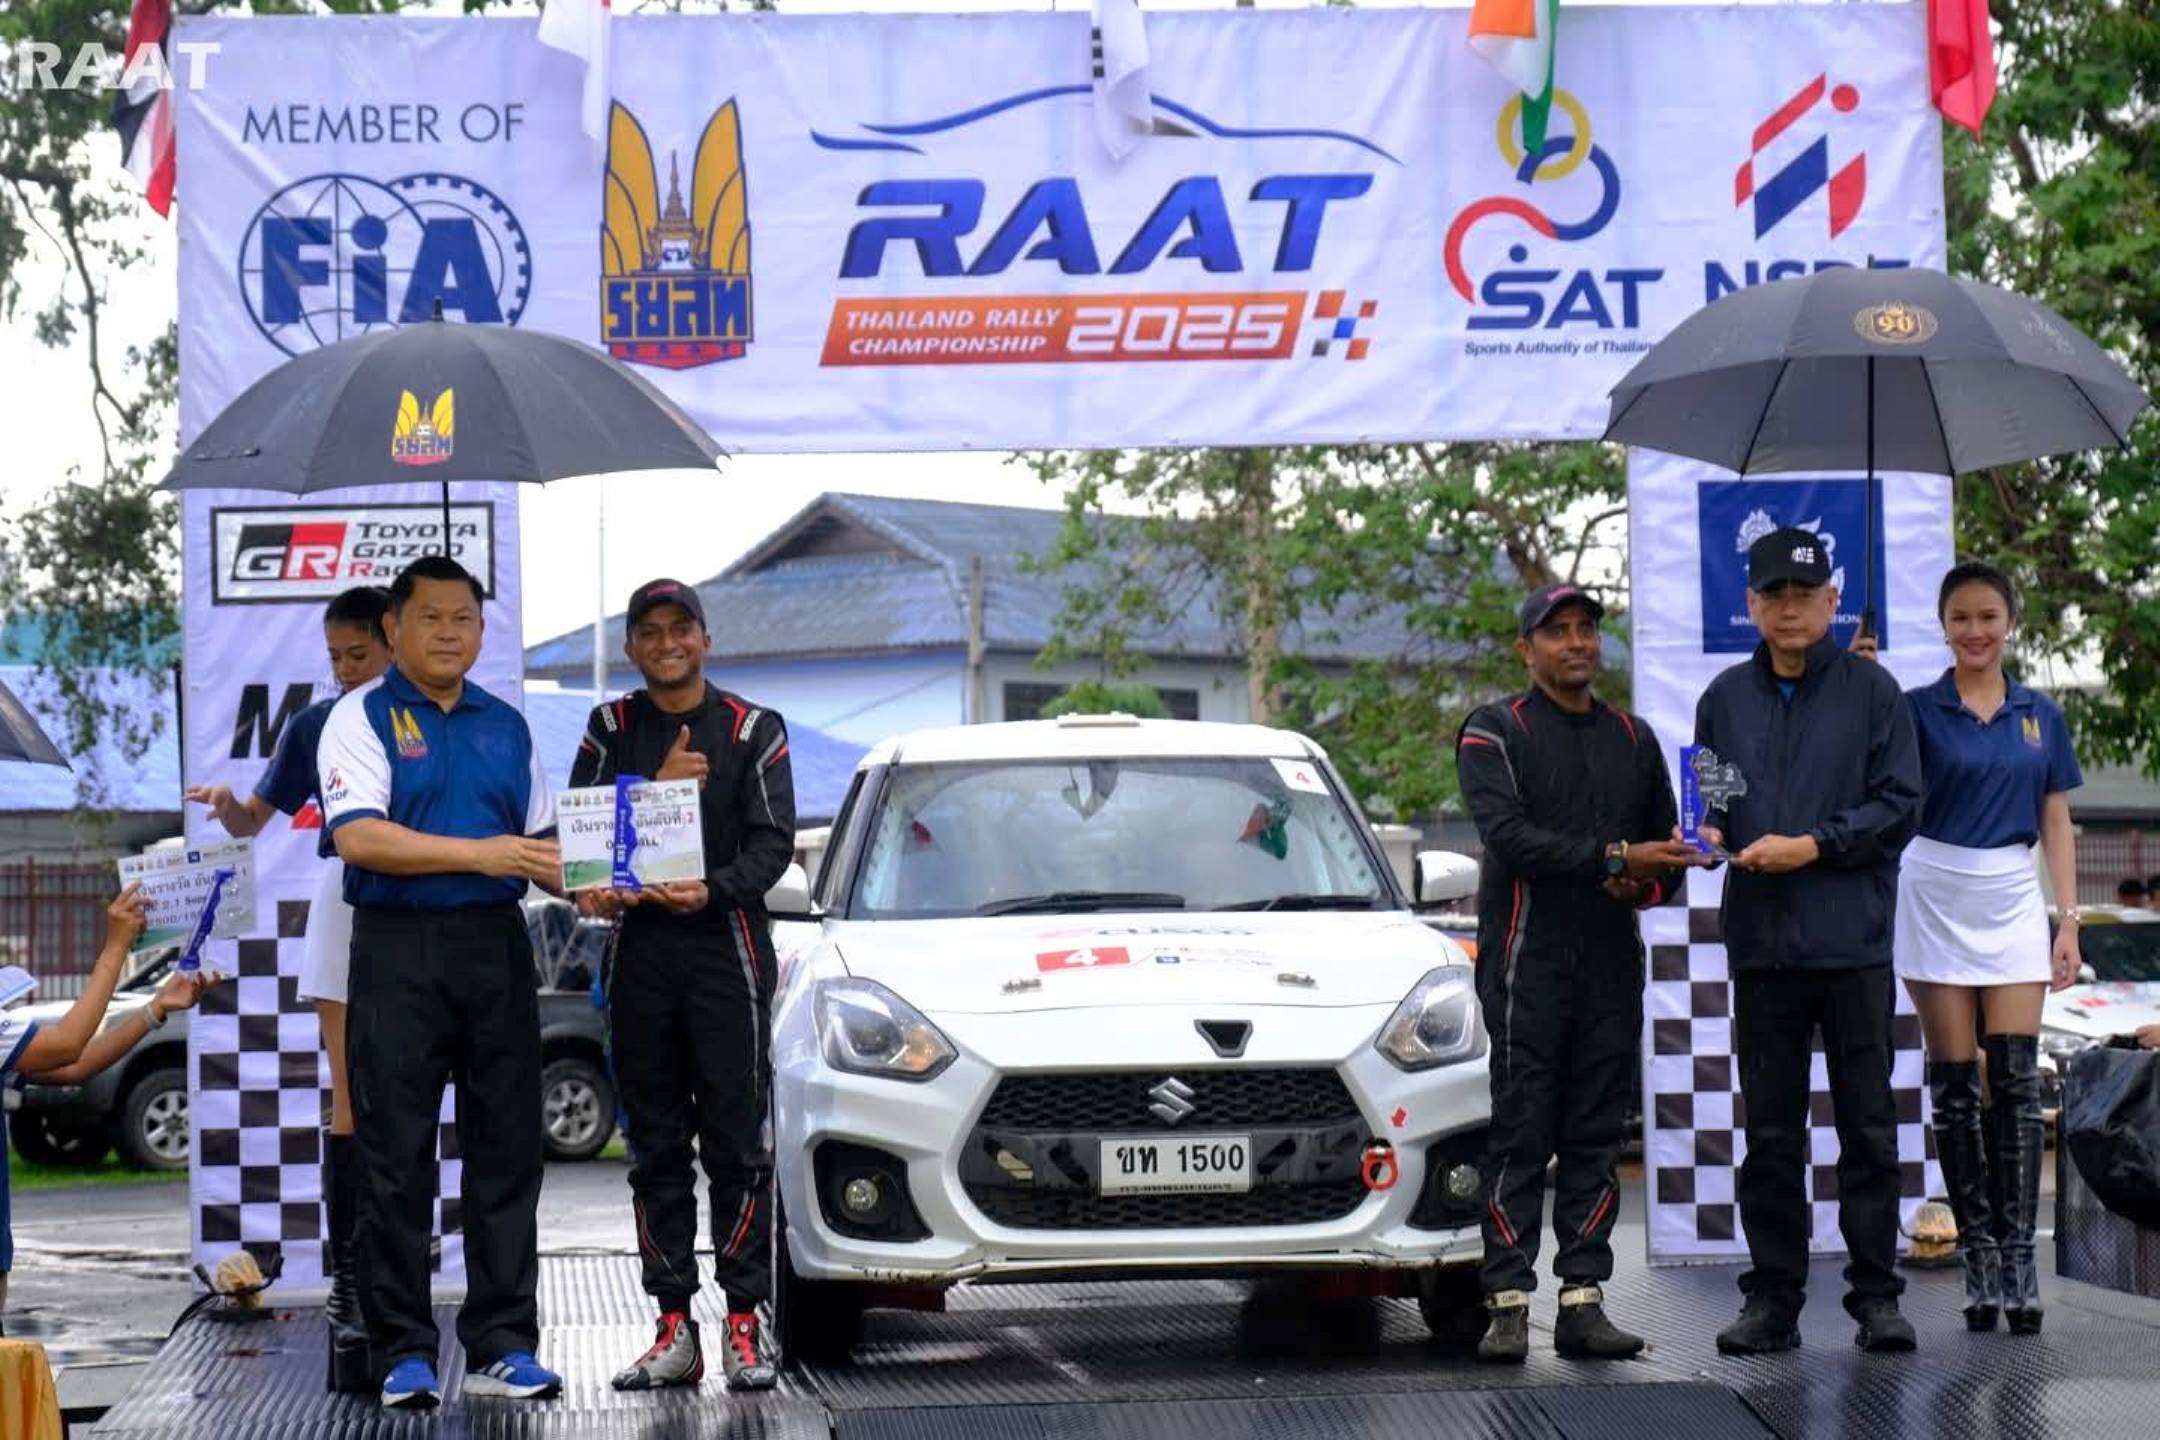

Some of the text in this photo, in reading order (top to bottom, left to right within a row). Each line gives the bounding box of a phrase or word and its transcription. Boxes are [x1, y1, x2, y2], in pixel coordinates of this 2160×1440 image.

[243, 103, 524, 144] MEMBER OF
[839, 174, 1374, 278] RAAT
[1466, 269, 1664, 330] SAT
[845, 308, 1062, 329] THAILAND RALLY
[1066, 303, 1290, 352] 2025
[848, 335, 1047, 354] CHAMPIONSHIP
[1465, 340, 1652, 357] Sports Authority of Thailan
[357, 522, 477, 538] TOYOTA
[232, 544, 341, 580] GR
[1177, 1144, 1244, 1173] 1500
